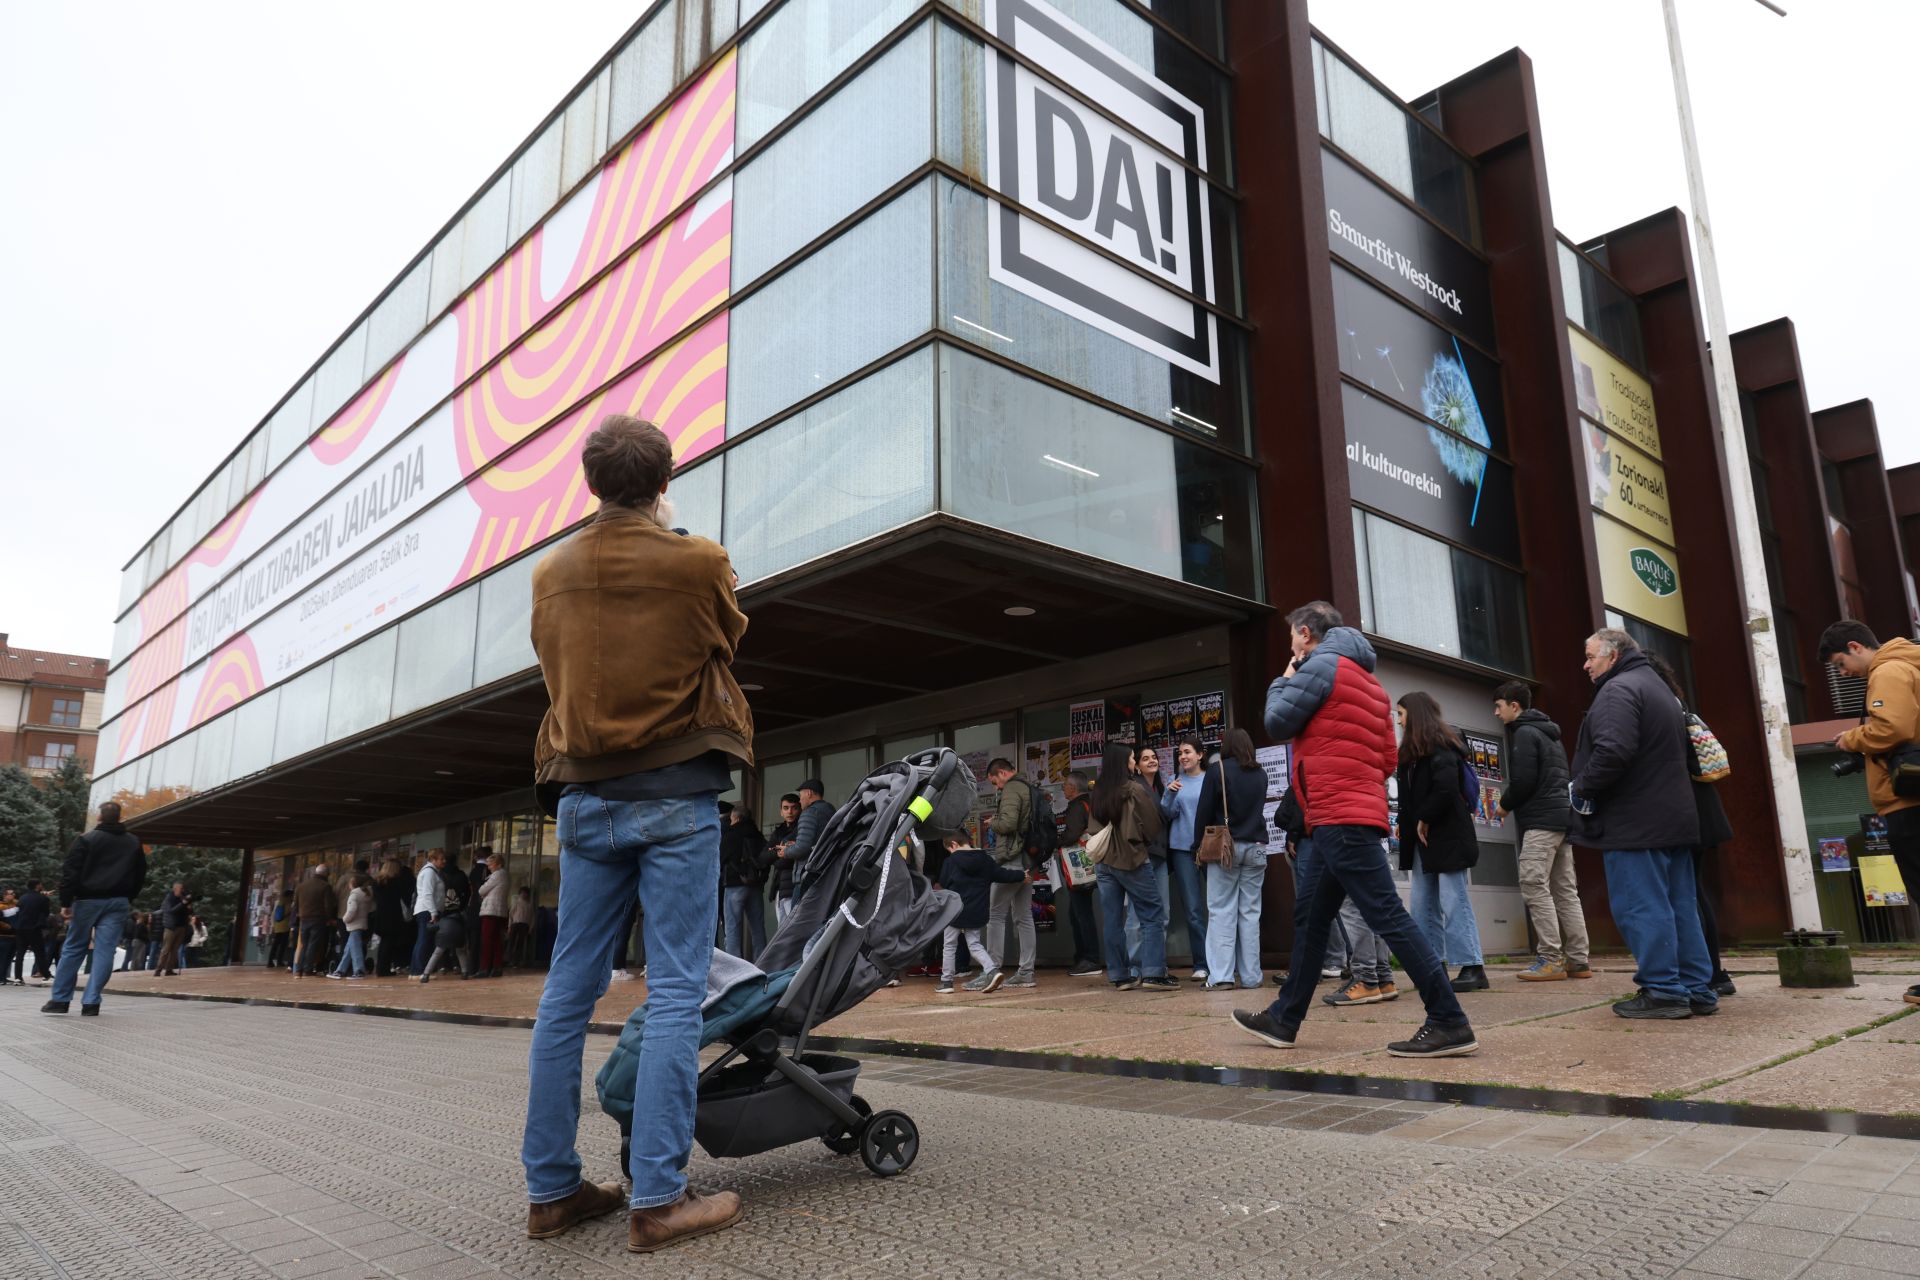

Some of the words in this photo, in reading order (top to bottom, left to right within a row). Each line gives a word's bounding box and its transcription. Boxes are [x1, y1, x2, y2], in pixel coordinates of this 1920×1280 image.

[1034, 86, 1177, 276] DA!
[1329, 208, 1396, 270] Smurfit
[1395, 251, 1463, 315] Westrock
[1606, 405, 1637, 440] irauten
[1638, 427, 1657, 452] dute
[1362, 443, 1442, 499] kulturarekin
[1615, 454, 1665, 500] Zorionak!
[242, 514, 334, 617] KULTURAREN
[336, 444, 425, 548] JAIALDIA
[1619, 481, 1637, 508] 60.
[1637, 502, 1669, 526] urteurrena
[331, 562, 379, 602] abenduaren
[379, 541, 402, 572] 5etik
[403, 532, 420, 557] 8ra
[1634, 555, 1672, 586] BAQUÉ
